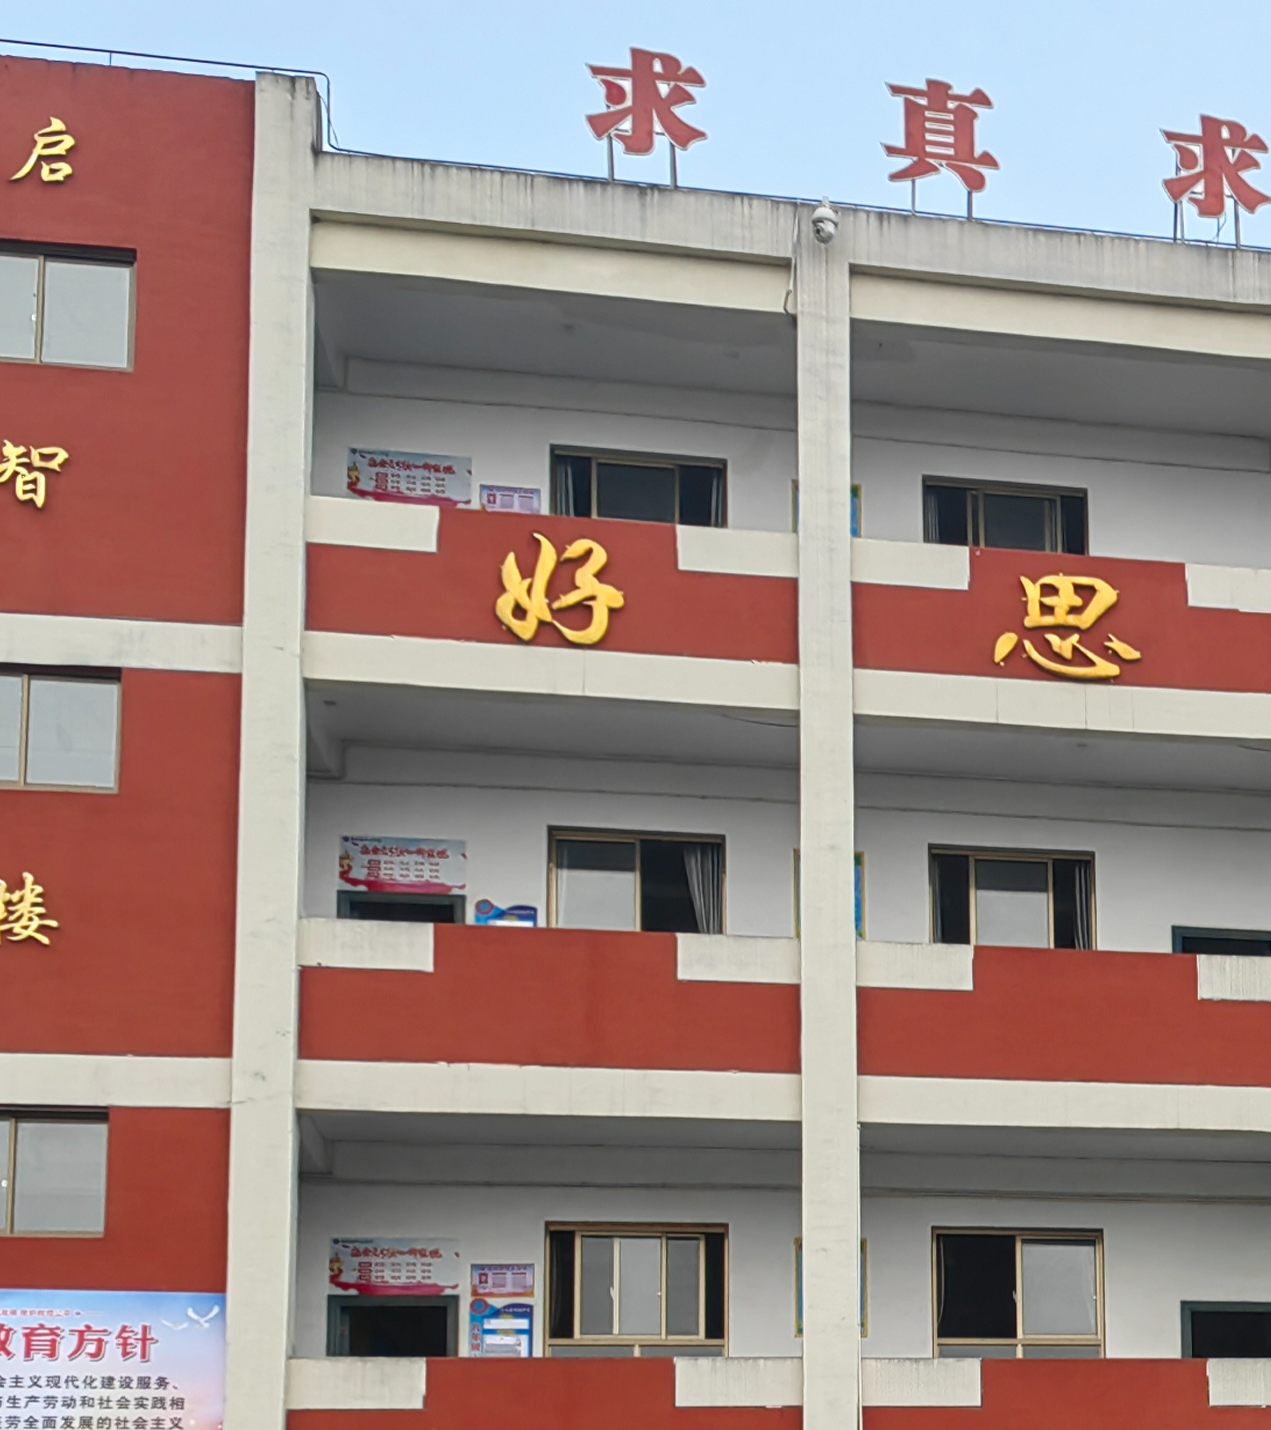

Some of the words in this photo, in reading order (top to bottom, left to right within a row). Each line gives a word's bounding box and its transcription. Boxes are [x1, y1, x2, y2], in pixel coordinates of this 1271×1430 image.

[10, 116, 75, 183] 启
[0, 440, 70, 509] 智
[494, 532, 625, 645] 好
[992, 571, 1143, 681] 思
[0, 1396, 186, 1411] 生产劳动和社会实践相
[0, 1416, 184, 1430] 劳全面发展的社会主义
